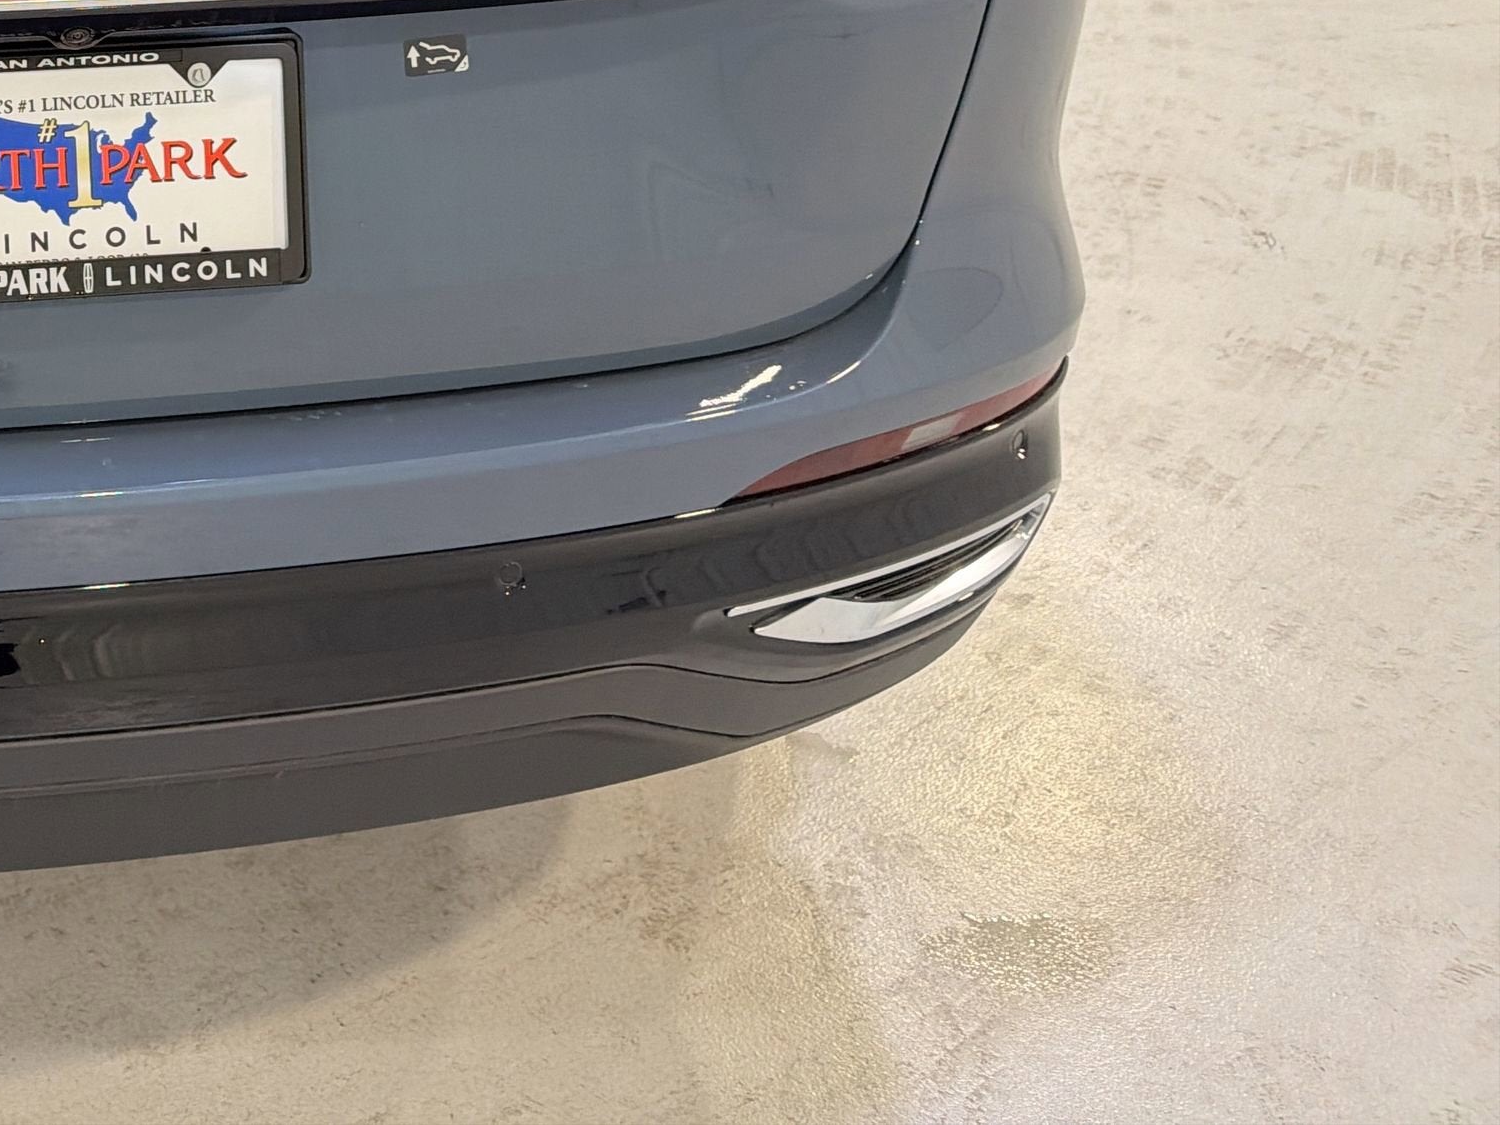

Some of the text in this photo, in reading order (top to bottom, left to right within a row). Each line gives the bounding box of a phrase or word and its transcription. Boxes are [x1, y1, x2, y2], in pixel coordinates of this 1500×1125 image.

[36, 52, 160, 68] ANTONIO
[18, 99, 36, 113] #1
[41, 93, 125, 112] LINCOLN
[129, 89, 217, 107] RETAILER
[100, 137, 249, 186] PARK
[105, 257, 268, 287] LINCOLN
